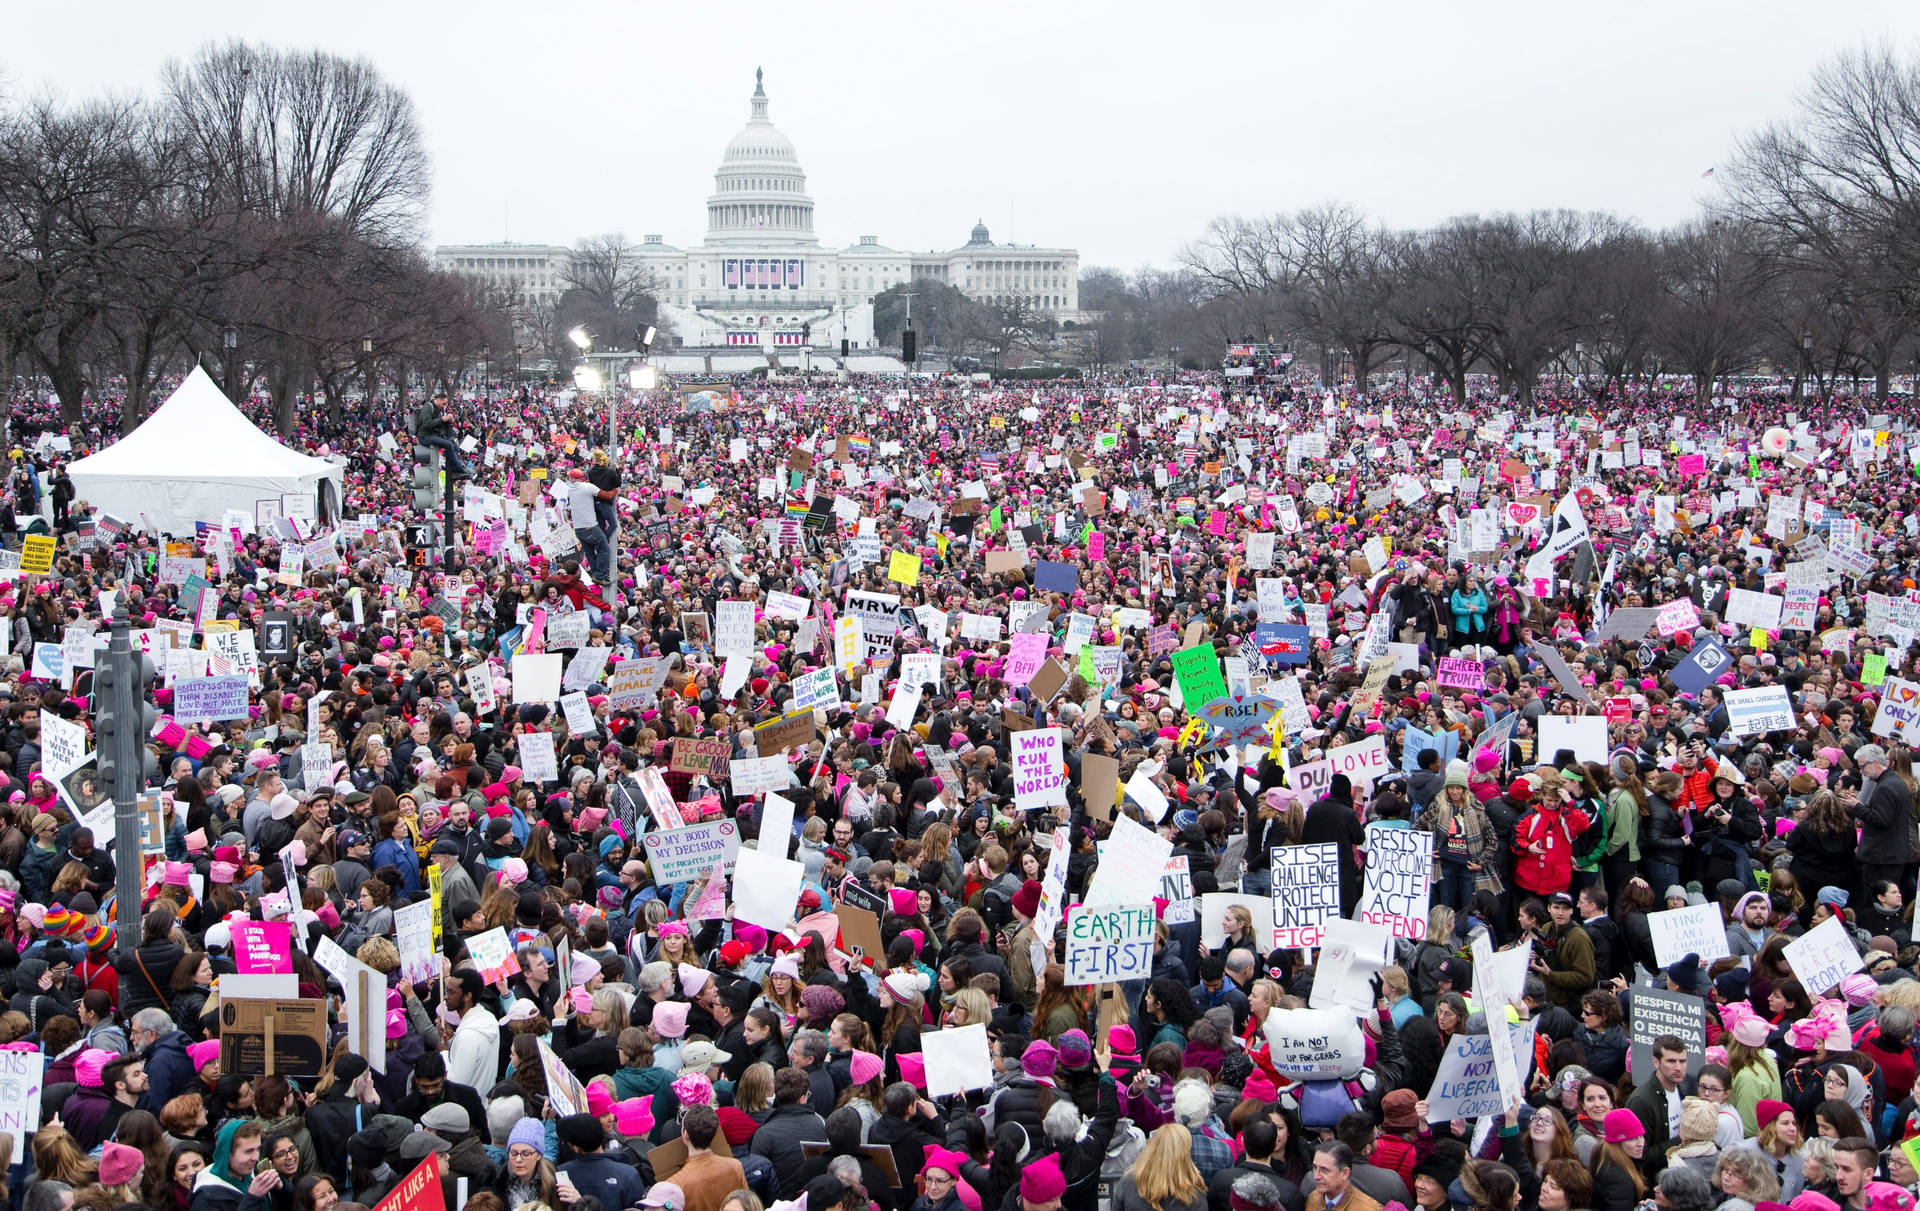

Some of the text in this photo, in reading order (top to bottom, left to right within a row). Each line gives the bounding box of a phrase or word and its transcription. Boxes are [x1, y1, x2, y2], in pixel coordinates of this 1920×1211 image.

[1788, 587, 1817, 599] TOLERANCE
[719, 603, 752, 611] HISTORY
[849, 598, 900, 614] MRW
[1784, 602, 1815, 610] RESPECT
[718, 624, 749, 634] EYES
[1787, 616, 1806, 626] ALL
[217, 633, 238, 646] WE
[718, 639, 751, 649] ON YOU
[615, 666, 655, 678] FUTURE
[795, 671, 831, 688] LESS MORE
[613, 678, 652, 693] FEMALE
[795, 682, 835, 697] BIRTH WELFARE
[203, 690, 246, 700] DISABILITY
[565, 698, 584, 708] RESIST
[796, 694, 816, 707] CONTROL
[1755, 694, 1787, 703] OVERCOME
[1884, 704, 1917, 722] ONLY
[1733, 714, 1790, 733] 一起更強
[50, 740, 77, 759] WITH
[678, 740, 732, 758] BE GROOVY
[1019, 735, 1055, 750] WHO
[54, 750, 71, 766] HER
[683, 753, 711, 768] LEAVE
[709, 758, 730, 774] MAN
[1017, 752, 1048, 766] RUN
[1331, 748, 1382, 774] LOVE
[1023, 764, 1052, 778] THE
[1016, 773, 1064, 794] WORLD?
[664, 829, 712, 845] MY BODY
[1370, 828, 1431, 852] RESIST
[656, 839, 725, 859] MY DECISION
[1271, 843, 1338, 865] RISE
[663, 861, 675, 870] MY
[676, 857, 702, 868] RIGHTS
[1365, 849, 1431, 876] OVERCOME
[665, 869, 681, 879] NOT
[686, 868, 695, 876] UP
[1271, 864, 1337, 887] CHALLENGE
[1366, 871, 1428, 897] VOTE!
[846, 889, 872, 909] mid-wife
[1272, 884, 1338, 908] PROTECT
[1369, 894, 1416, 915] ACT
[1175, 910, 1188, 921] US
[1072, 909, 1155, 940] EARTH
[1273, 926, 1326, 948] FIGH
[1797, 938, 1814, 957] WE
[1801, 936, 1853, 975] ARE THE
[1068, 942, 1154, 976] FIRST
[1806, 960, 1852, 993] PEOPLE
[1634, 994, 1701, 1015] RESPETA MI
[1634, 1008, 1701, 1028] EXISTENCIA
[1523, 1028, 1532, 1044] IS
[1634, 1020, 1701, 1042] O ESPERA
[1282, 1037, 1290, 1048] I
[1309, 1036, 1328, 1048] NOT
[1314, 1050, 1341, 1060] GRABS
[1463, 1061, 1494, 1076] NOT
[1442, 1079, 1499, 1099] LIBERAL
[1458, 1100, 1503, 1116] CONSPI
[404, 1164, 434, 1203] LIKE A
